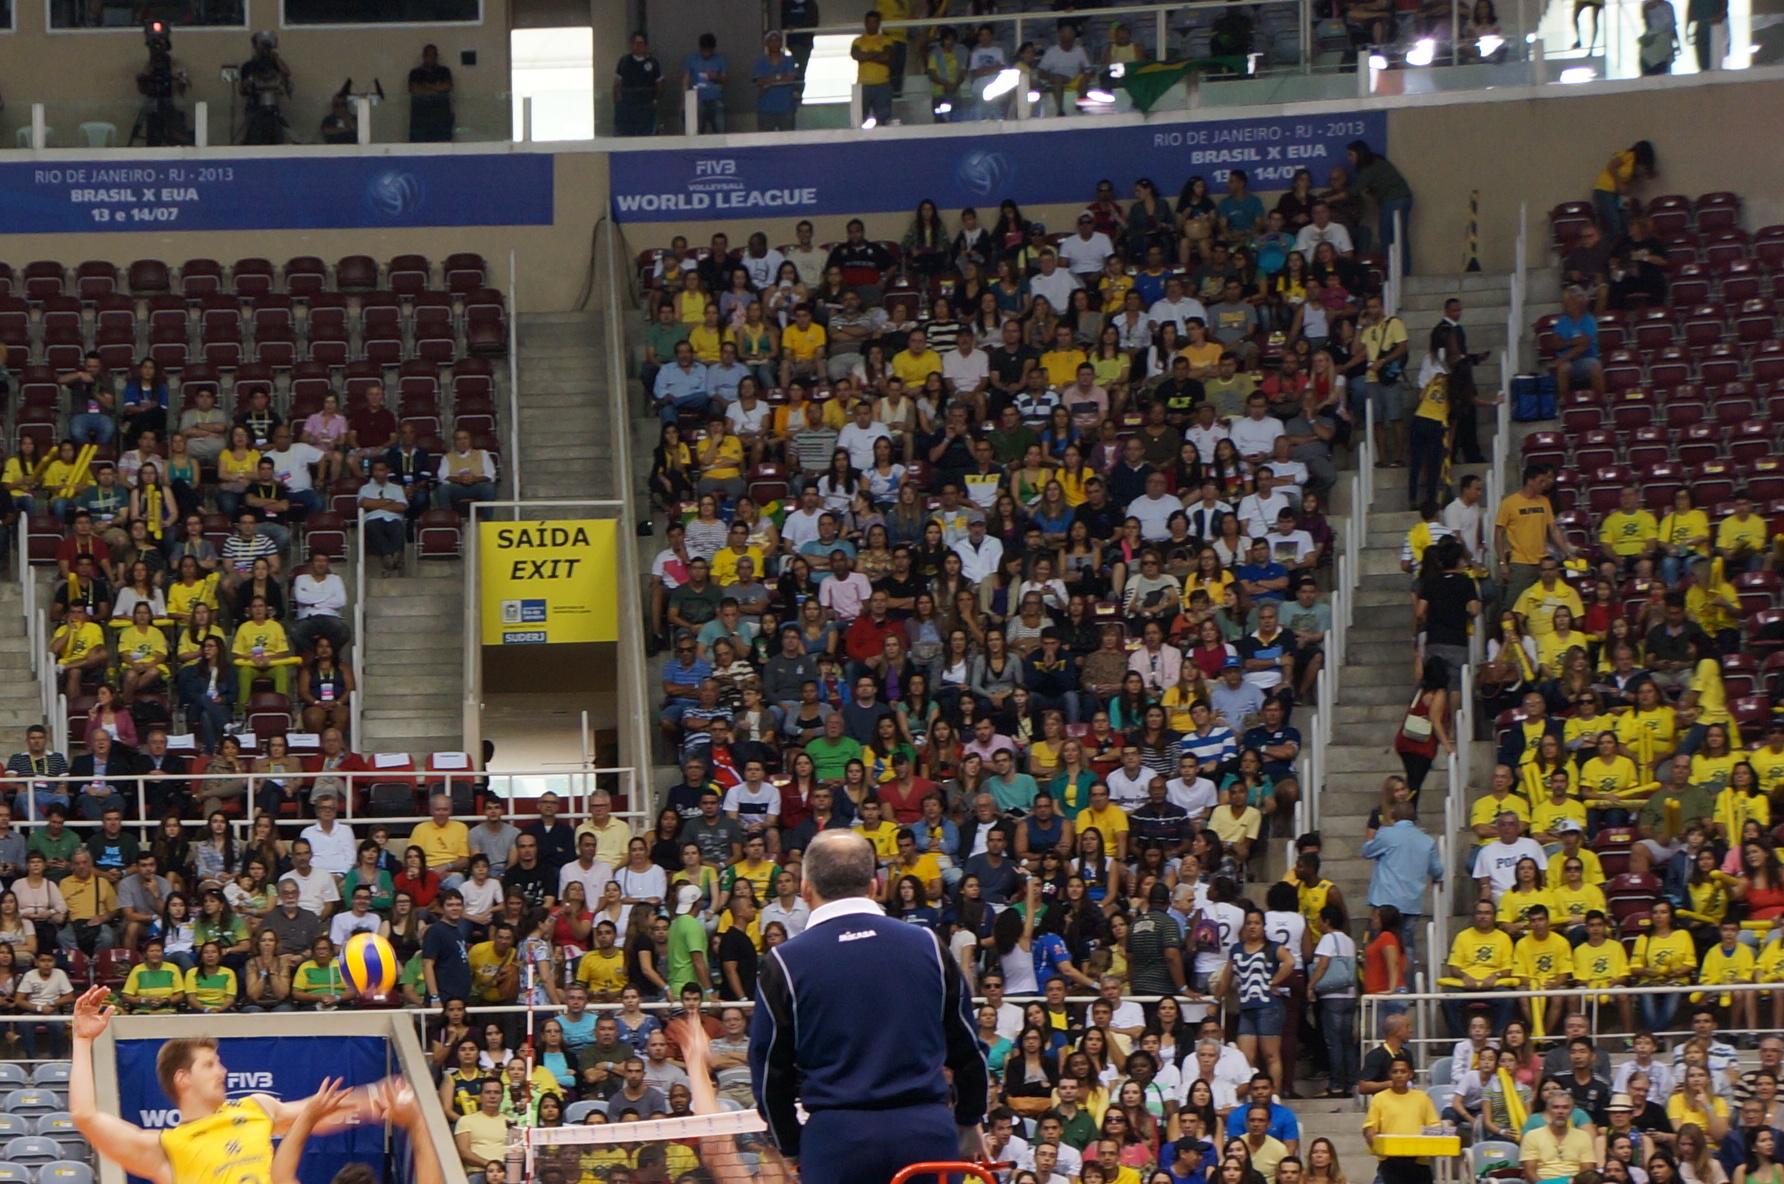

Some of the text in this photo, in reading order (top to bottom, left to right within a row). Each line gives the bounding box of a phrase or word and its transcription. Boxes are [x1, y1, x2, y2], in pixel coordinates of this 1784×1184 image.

[1154, 120, 1365, 148] RIO DE JANEIRO RJ 2013
[1191, 142, 1327, 165] BRASIL X EUA
[35, 167, 234, 184] RIO DE JANEIRO RJ 2013
[695, 159, 736, 175] FIVB
[1213, 168, 1230, 184] 13
[70, 186, 200, 203] BRASIL X EUA
[617, 187, 817, 212] WORLD LEAGUE
[91, 206, 180, 223] 13 e 14/07
[497, 520, 591, 549] SAÍDA
[509, 558, 582, 580] EXIT
[504, 632, 546, 643] SUDERJ
[226, 1071, 274, 1088] FIVB
